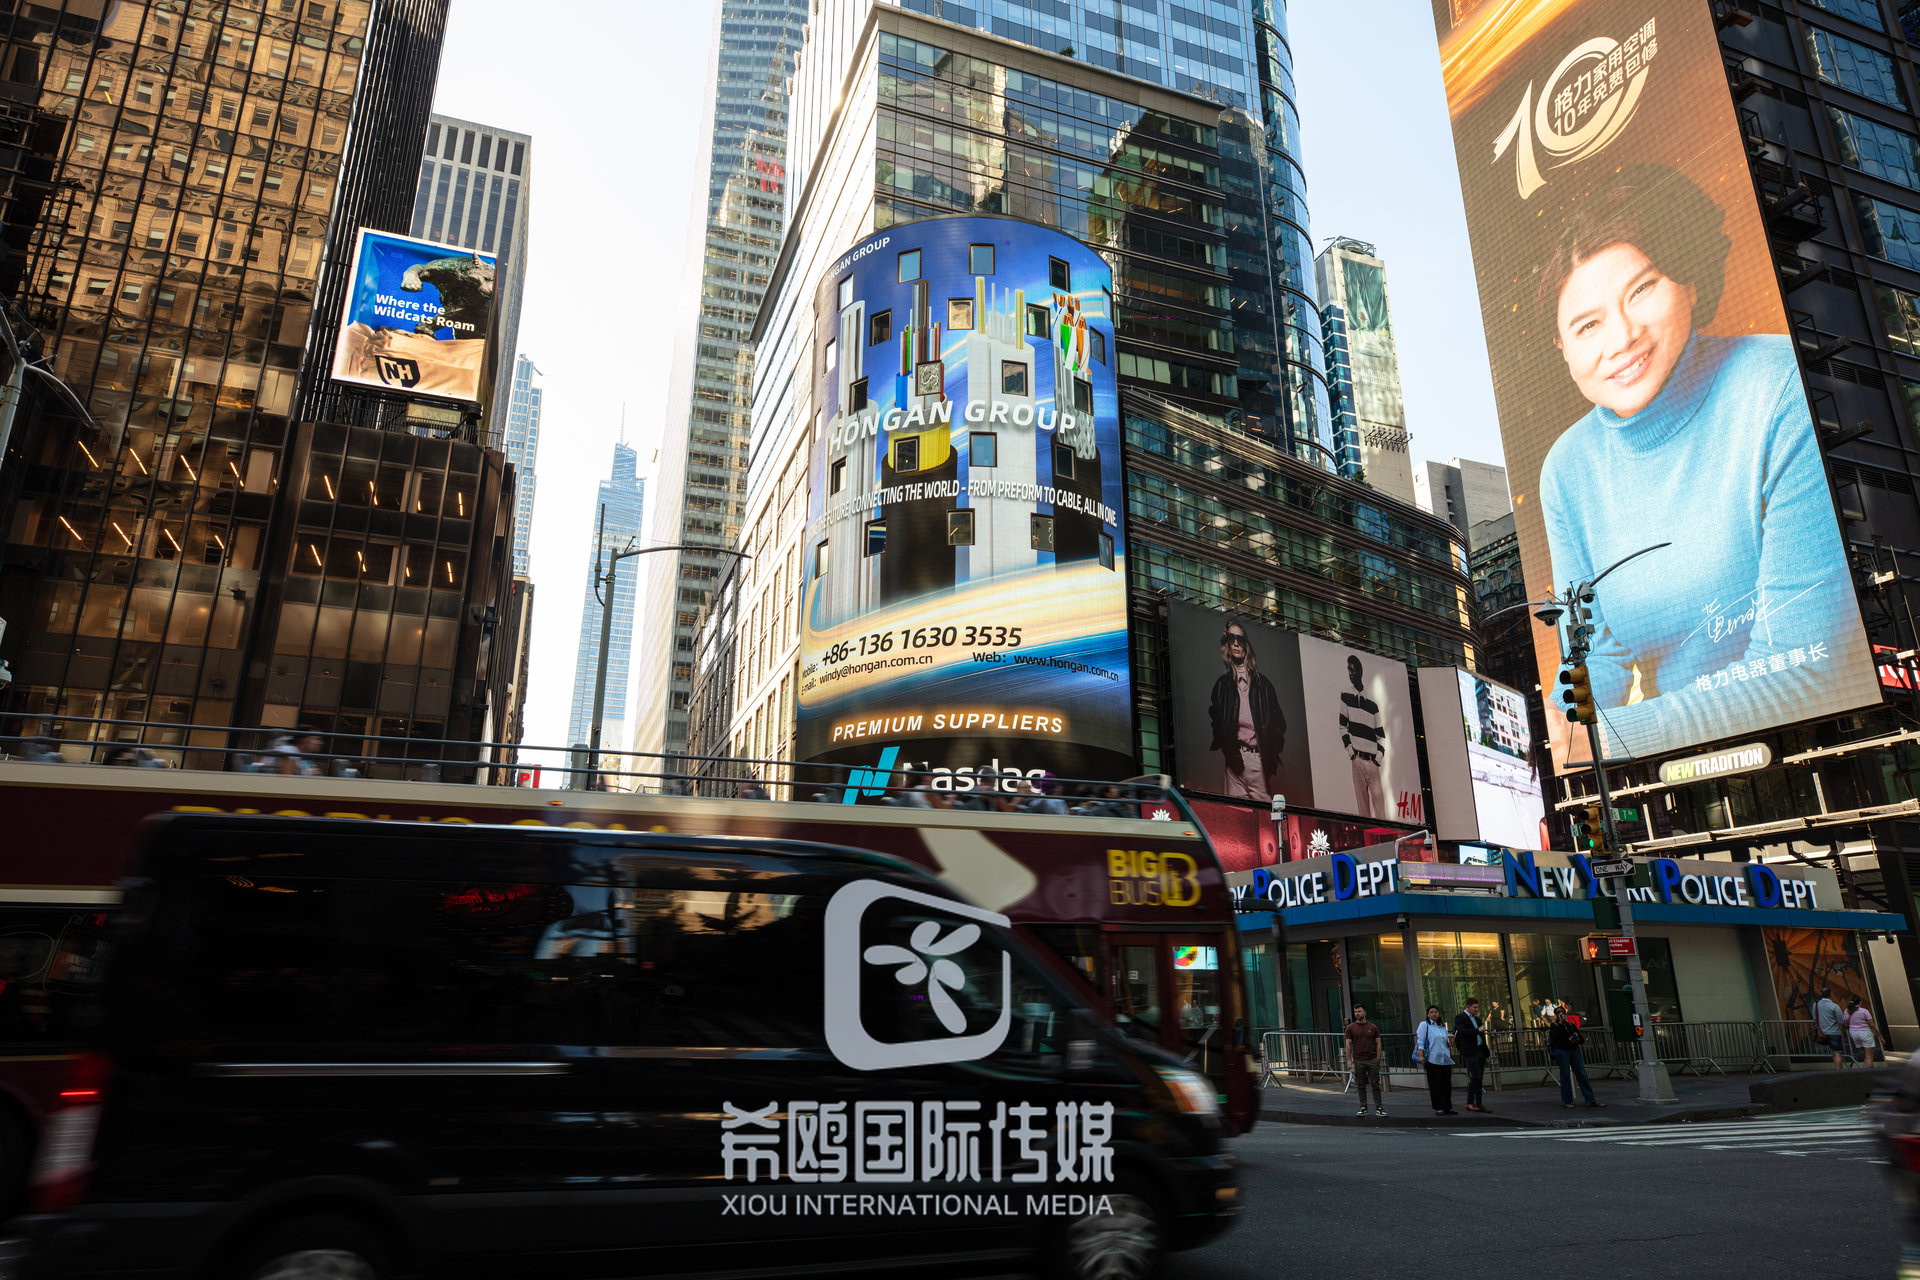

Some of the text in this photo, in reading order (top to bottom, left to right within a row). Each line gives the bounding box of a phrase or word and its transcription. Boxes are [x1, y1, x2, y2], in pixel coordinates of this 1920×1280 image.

[1554, 17, 1656, 118] 格力家用空调
[1554, 37, 1658, 136] 10年免费包修
[853, 237, 890, 261] GROUP
[373, 305, 475, 332] Wildcats Roam
[375, 293, 446, 315] Where the
[828, 400, 1076, 456] HONGAN GROUP
[851, 486, 904, 515] CONNECTING
[905, 482, 922, 501] THE
[924, 479, 960, 499] WORLD
[968, 479, 996, 497] FROM
[997, 480, 1043, 502] PREFORM
[1043, 487, 1056, 504] TO
[1056, 488, 1083, 514] CABLE,
[1083, 497, 1097, 517] ALL
[1097, 502, 1104, 520] IN
[1104, 506, 1118, 528] ONE.
[822, 631, 893, 666] +86-136
[901, 627, 957, 649] 1630
[962, 625, 1022, 647] 3535
[819, 654, 933, 685] windy@hongan.com.cn
[972, 651, 1119, 682] Web: www.hongan.com.cn
[1695, 641, 1829, 693] 格力电器董事长
[832, 713, 1063, 742] PREMIUM SUPPLIERS
[1397, 790, 1422, 822] H&M
[1107, 849, 1159, 878] BIG
[1502, 848, 1576, 898] NEW
[1654, 858, 1749, 907] POLICE
[1748, 864, 1817, 909] DEPT
[1595, 863, 1629, 873] ONE WAY
[1109, 880, 1162, 906] BUS
[1252, 868, 1326, 909] POLICE
[1331, 853, 1398, 900] DEPT
